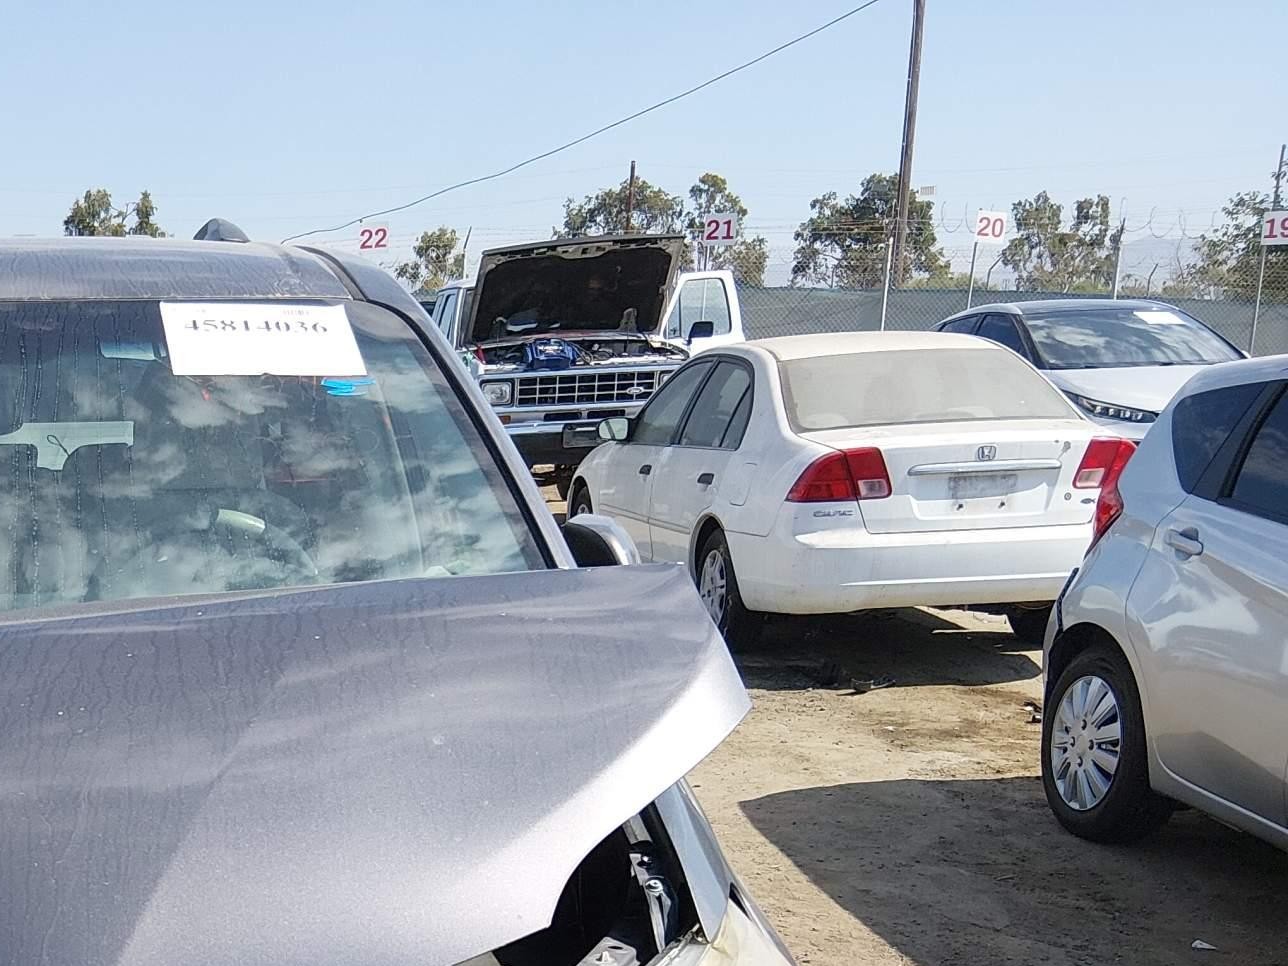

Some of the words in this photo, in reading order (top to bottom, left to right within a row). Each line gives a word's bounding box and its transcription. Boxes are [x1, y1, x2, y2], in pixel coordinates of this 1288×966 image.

[359, 227, 387, 249] 22
[705, 219, 734, 241] 21
[977, 216, 1004, 238] 20
[183, 318, 328, 333] 45814036
